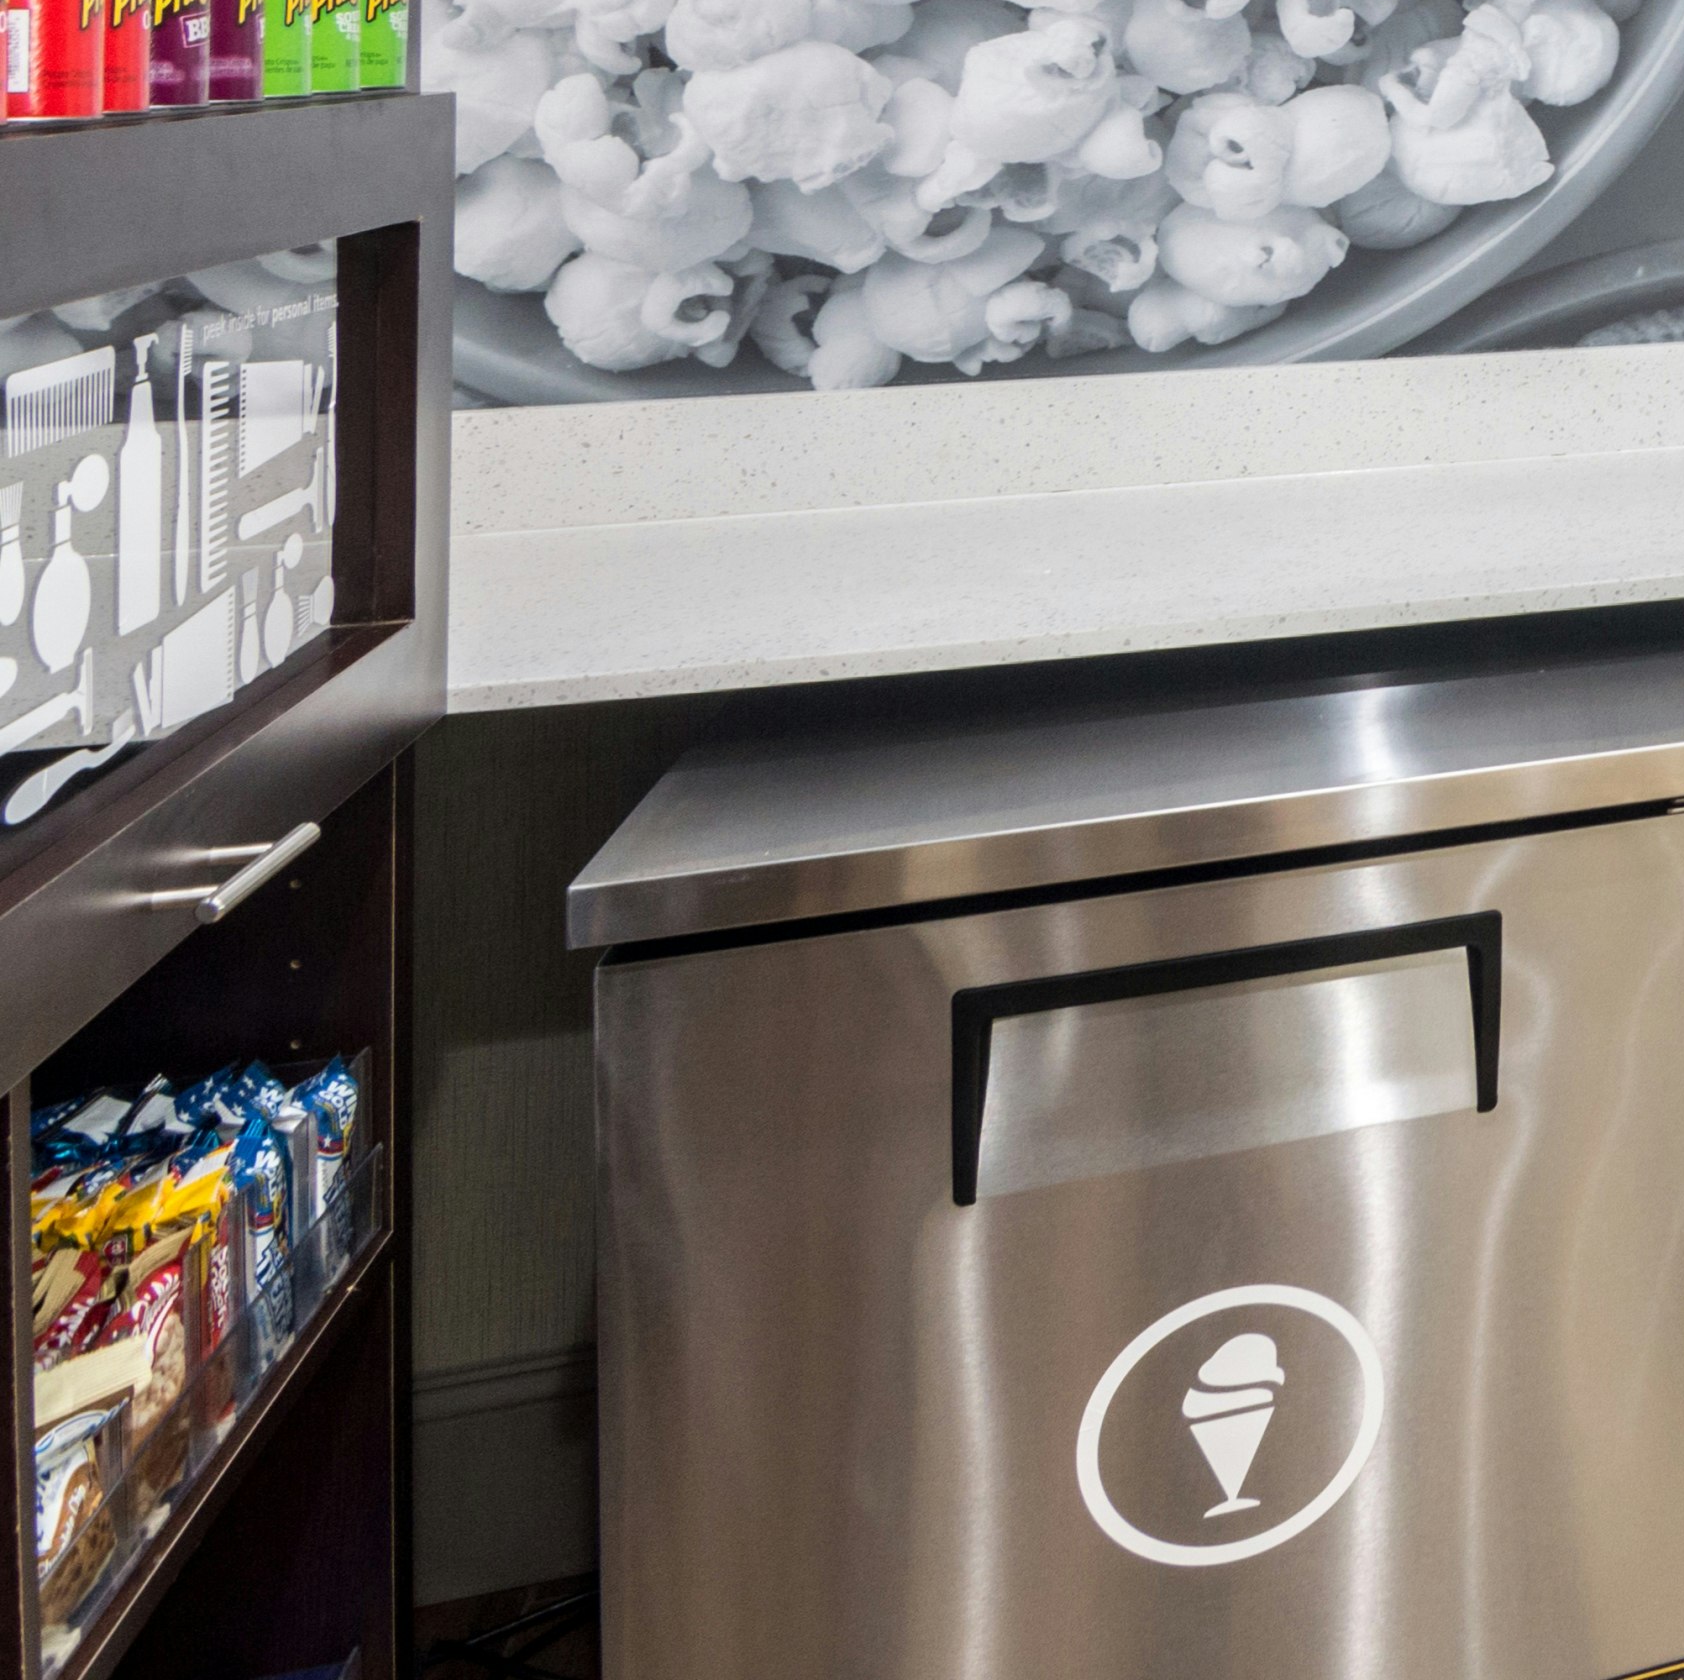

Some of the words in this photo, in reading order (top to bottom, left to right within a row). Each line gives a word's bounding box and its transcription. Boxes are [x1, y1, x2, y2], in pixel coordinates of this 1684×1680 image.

[203, 313, 224, 346] peek
[225, 308, 256, 334] inside
[256, 305, 270, 326] for
[272, 295, 311, 328] personal
